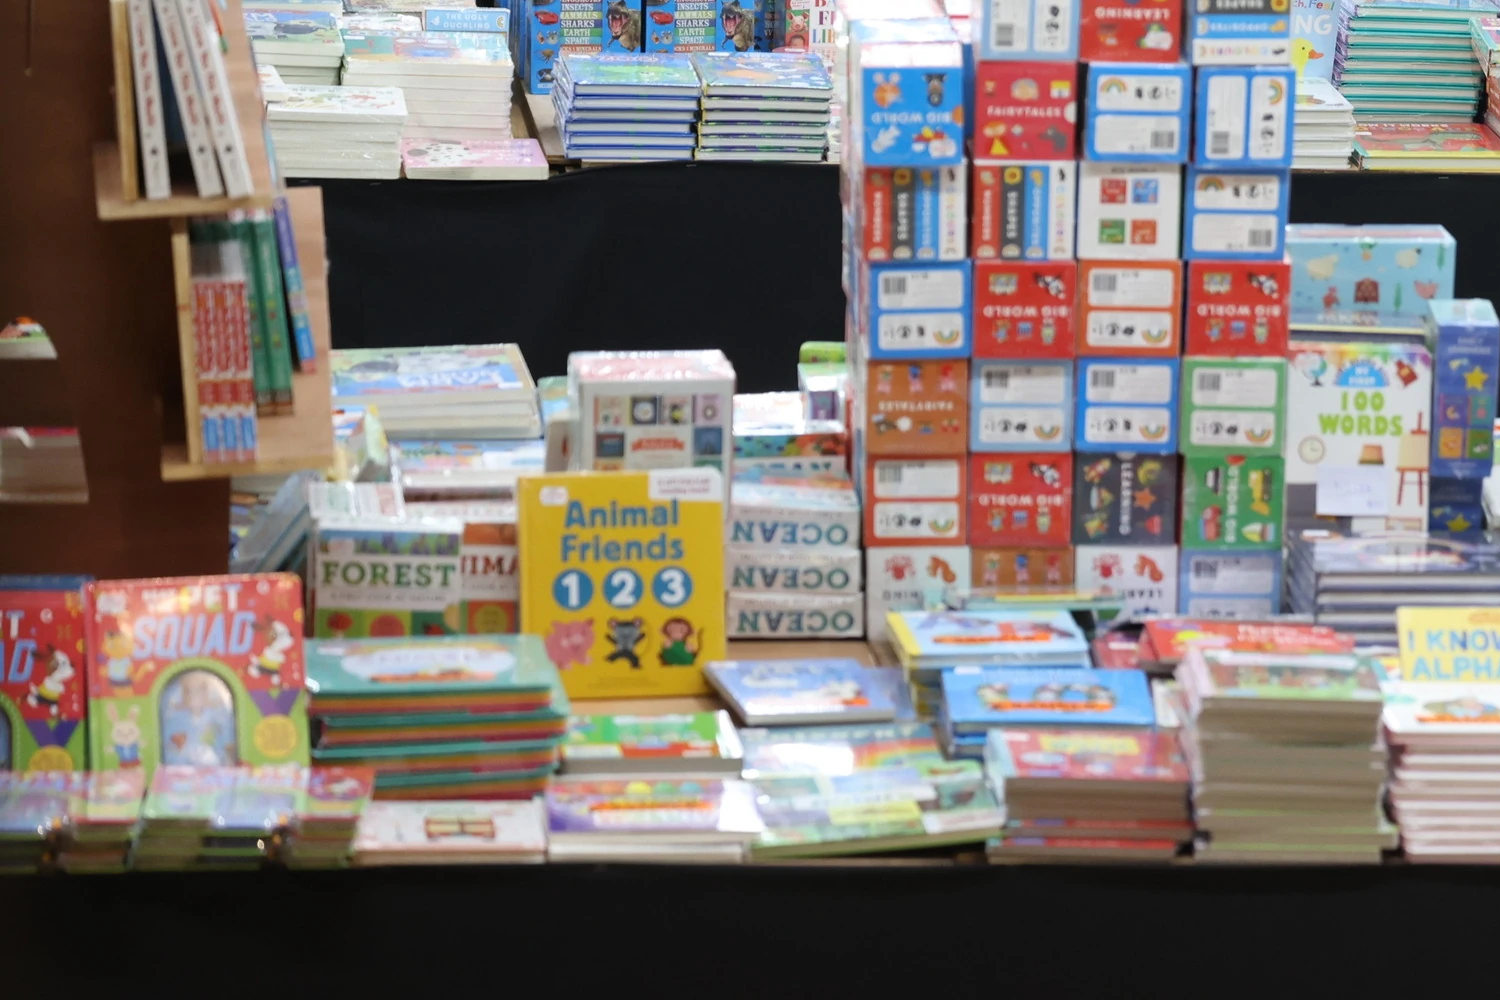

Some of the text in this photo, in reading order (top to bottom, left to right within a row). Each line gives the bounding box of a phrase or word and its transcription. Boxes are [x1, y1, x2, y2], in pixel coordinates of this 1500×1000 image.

[1095, 7, 1170, 19] LEARNING
[1341, 391, 1385, 411] 100
[1318, 415, 1404, 435] WORDS
[564, 499, 678, 529] Animal
[730, 522, 848, 546] OCEAN
[561, 534, 683, 562] Friends
[321, 560, 456, 588] FOREST
[561, 568, 686, 607] 1 2 3
[132, 611, 256, 660] SQUAD
[1408, 632, 1415, 651] I
